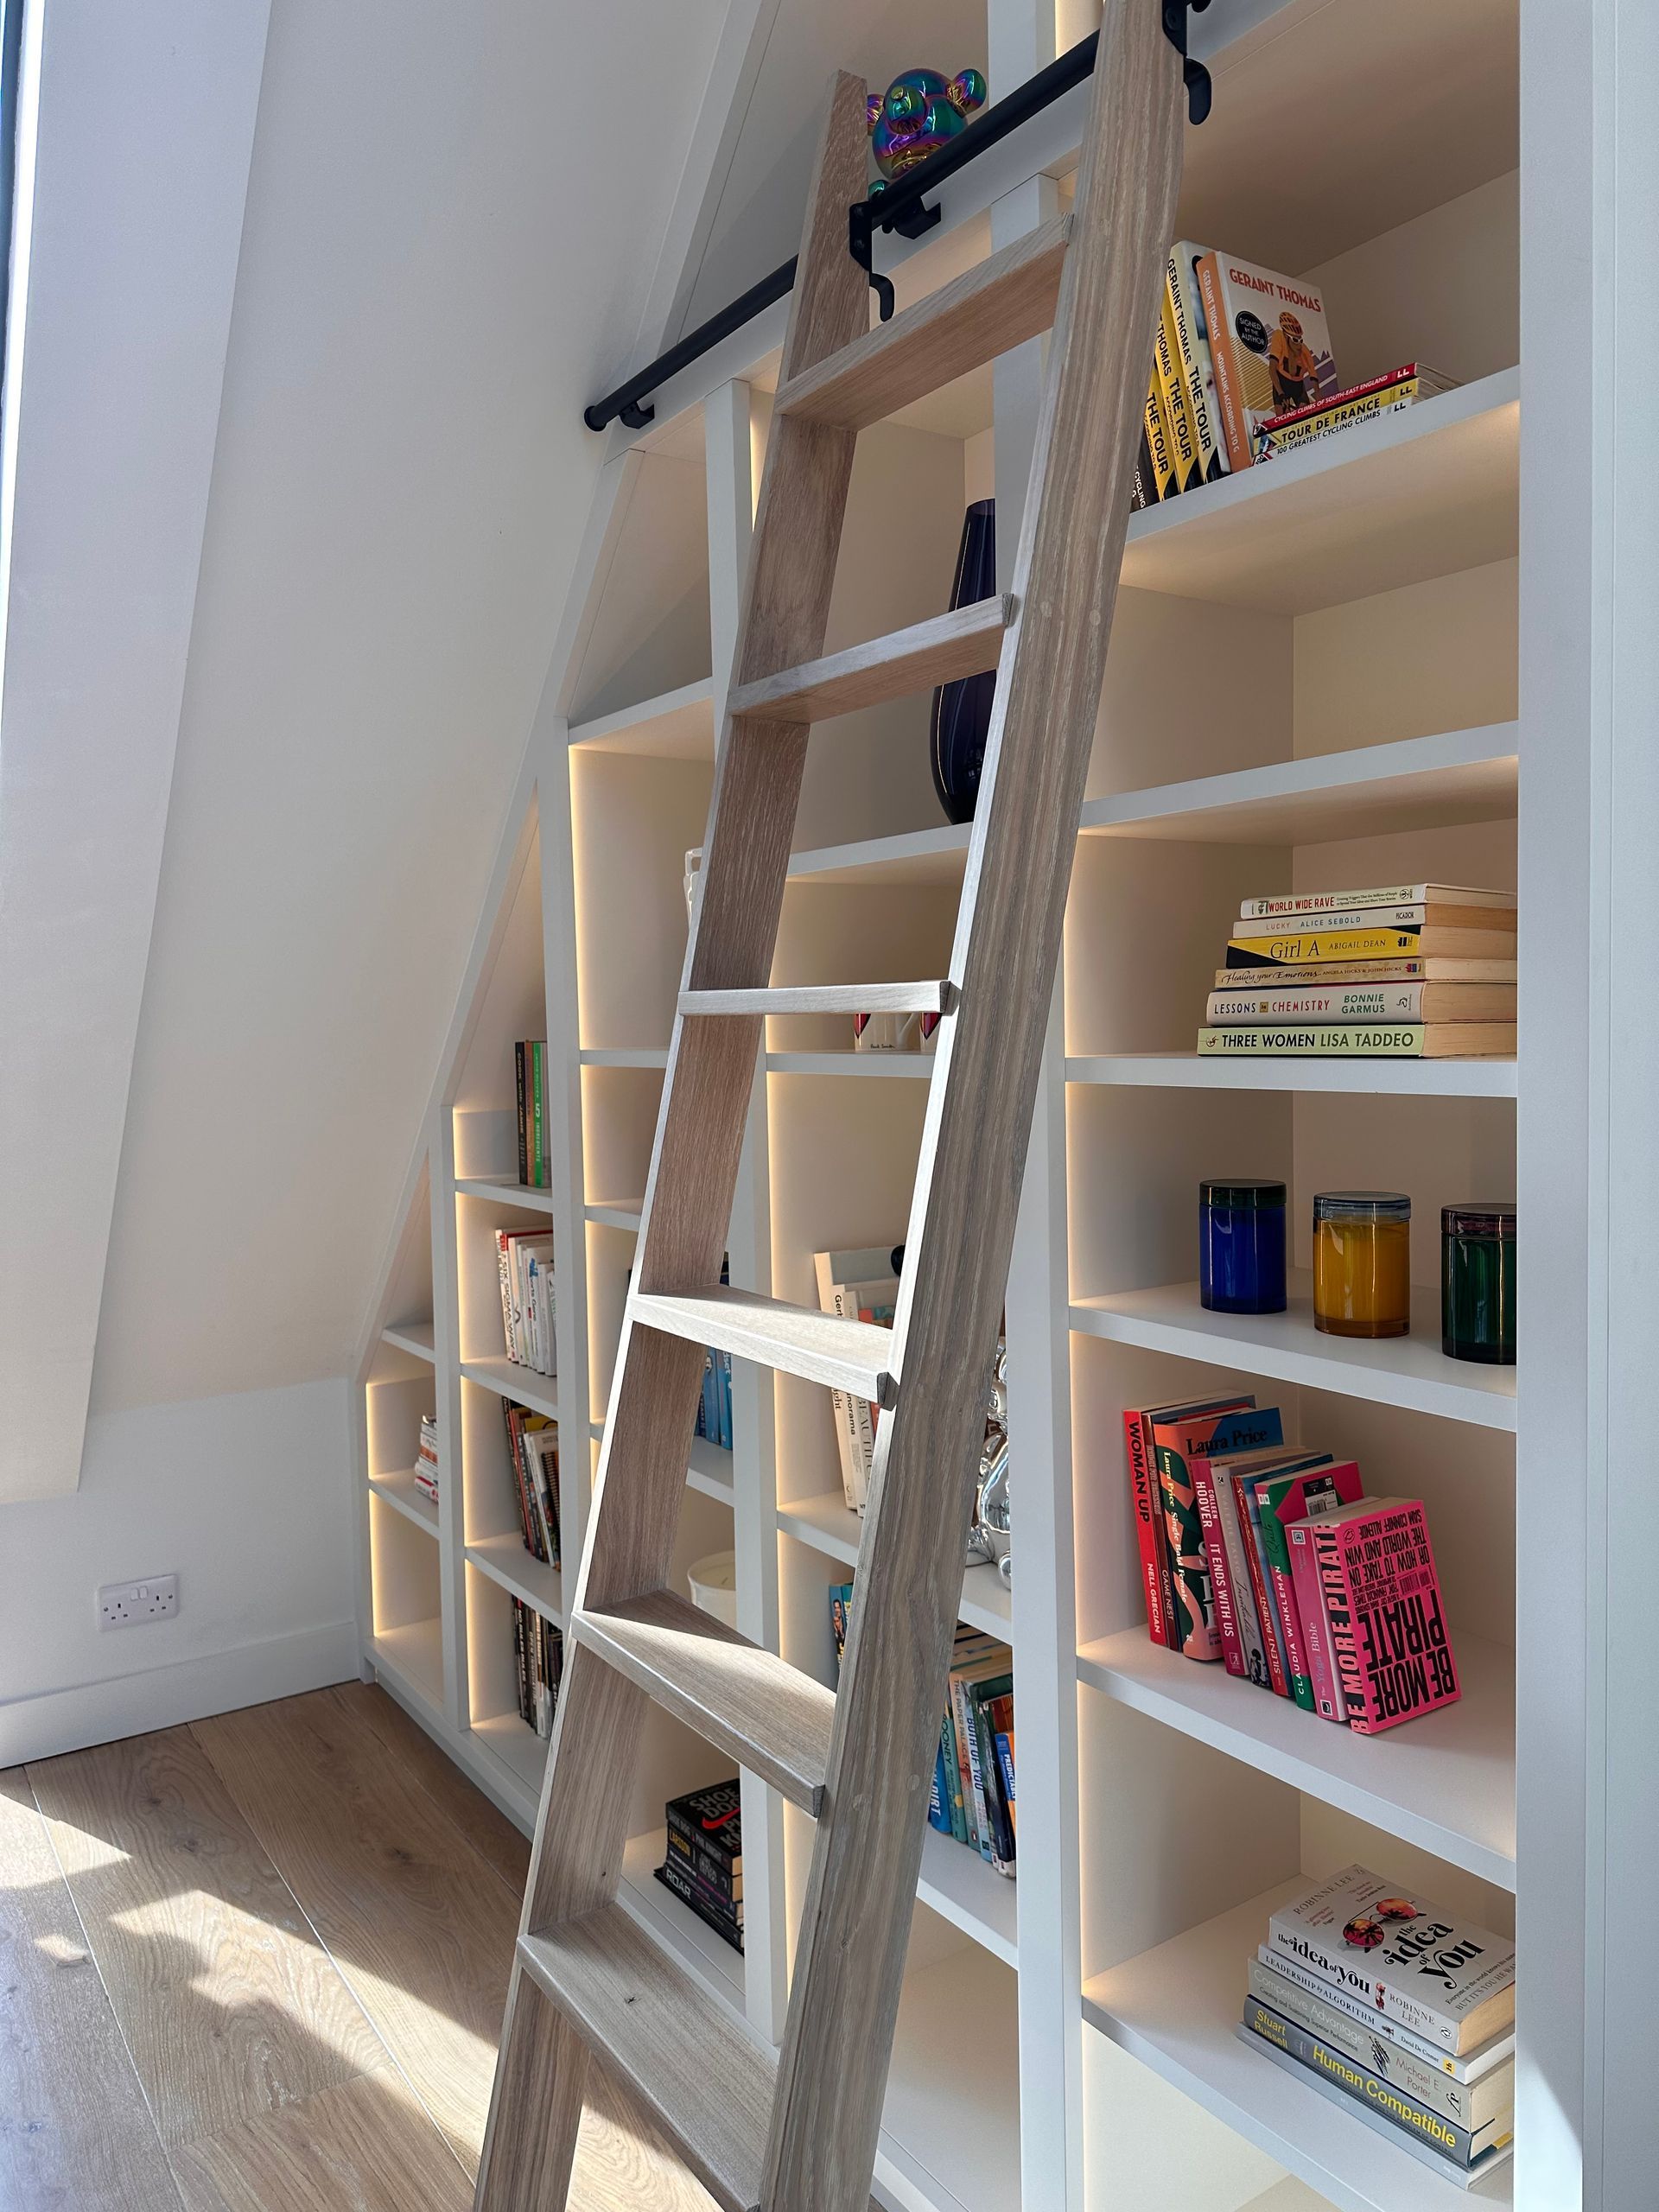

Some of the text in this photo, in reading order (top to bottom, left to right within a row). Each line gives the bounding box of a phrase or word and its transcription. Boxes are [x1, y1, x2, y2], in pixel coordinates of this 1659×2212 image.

[1203, 270, 1221, 340] GERAINT THOMAS
[1230, 268, 1321, 312] GERAINT THOMAS
[1168, 258, 1192, 365] GERAINT THOMAS
[1239, 317, 1262, 330] SIGNED
[1157, 324, 1172, 377] THOMAS
[1242, 334, 1265, 346] AUTHOR
[1190, 365, 1211, 452] THE TOUR
[1217, 351, 1227, 394] MOUNTAINS
[1224, 394, 1236, 434] ACCORDING
[1231, 435, 1238, 446] TO
[1274, 410, 1298, 423] CYCLING
[1298, 403, 1316, 415] CLIMBS
[1325, 387, 1358, 404] SOUTH-EAST
[1360, 375, 1388, 391] ENGLAND
[1147, 392, 1168, 474] THE TOUR
[1169, 378, 1192, 461] THE TOUR
[1277, 410, 1381, 454] 100 GREATEST CYCLING CLIMBS
[1282, 424, 1312, 443] TOUR
[1316, 418, 1331, 429] DE
[1334, 398, 1380, 423] FRANCE
[1135, 471, 1146, 508] CYCLING
[1266, 916, 1361, 931] LUCKY ALICE SEBOLD
[1268, 896, 1335, 913] WORLD WIDE RAVE
[1270, 940, 1319, 959] Girl A
[1329, 939, 1386, 950] ABIGAIL DEAN
[1221, 970, 1321, 984] Healing your Emotions
[1214, 1000, 1330, 1014] LESSONS CHEMISTRY
[1342, 1005, 1385, 1014] GARMUS
[1344, 994, 1384, 1003] BONNIE
[1222, 1034, 1315, 1047] THREE WOMEN
[1320, 1033, 1414, 1047] LISA TADDEO
[504, 1282, 512, 1319] SIGMA
[847, 1392, 855, 1435] norama
[1185, 1427, 1268, 1456] Laura Price
[1128, 1421, 1150, 1522] WOMAN UP
[1196, 1481, 1212, 1528] HOOVER
[1208, 1489, 1217, 1519] COLLEEN
[1163, 1452, 1172, 1479] Laura
[1171, 1511, 1179, 1539] Single
[1178, 1568, 1188, 1603] Female
[1358, 1509, 1422, 1540] SAM CONNIFF ALLENDE
[1344, 1526, 1427, 1567] THE WORLD AND WIN
[1162, 1569, 1171, 1598] GAME
[1349, 1545, 1430, 1587] OR HOW TO TAKE ON
[1147, 1563, 1160, 1633] NELL GRECIAN
[1210, 1543, 1234, 1637] IT ENDS WITH US
[1260, 1597, 1281, 1675] SILENT PATIENT
[1275, 1566, 1304, 1695] CLAUDIA WINKLEMAN
[1309, 1622, 1320, 1653] Bible
[1357, 1589, 1447, 1673] PIRATE
[1332, 1621, 1367, 1697] MORE
[1368, 1647, 1456, 1723] BE MORE
[956, 1698, 964, 1725] PAPER
[1346, 1700, 1370, 1733] BE
[958, 1726, 968, 1759] PALACE
[967, 1717, 983, 1791] BOTH OF YOU
[689, 1788, 739, 1810] SHOE
[665, 1867, 691, 1900] ROAR
[1293, 1885, 1335, 1915] ROBINNE
[1336, 1874, 1355, 1889] LEE
[1382, 1923, 1454, 1966] idea
[1399, 1924, 1417, 1936] the
[1278, 1933, 1290, 1945] the
[1288, 1937, 1329, 1970] idea
[1337, 1966, 1370, 1994] you
[1417, 1940, 1485, 1989] you
[1419, 1954, 1431, 1965] of
[1254, 1970, 1307, 2011] Competitive
[1311, 2005, 1364, 2044] Advantage
[1266, 1955, 1375, 2024] LEADERSHIP by ALGORITHM
[1445, 1987, 1465, 2005] Everyone
[1476, 1971, 1489, 1983] world
[1455, 1999, 1471, 2011] BUT
[1481, 1978, 1498, 1991] YOU
[1497, 1972, 1507, 1983] HE
[1256, 2010, 1286, 2036] Stuart
[1389, 1993, 1434, 2024] ROBINNE
[1402, 2011, 1421, 2027] LEE
[1254, 2020, 1288, 2049] Russell
[1396, 2057, 1431, 2085] Michael
[1408, 2076, 1431, 2098] Porter
[1313, 2045, 1456, 2148] Human Compatible
